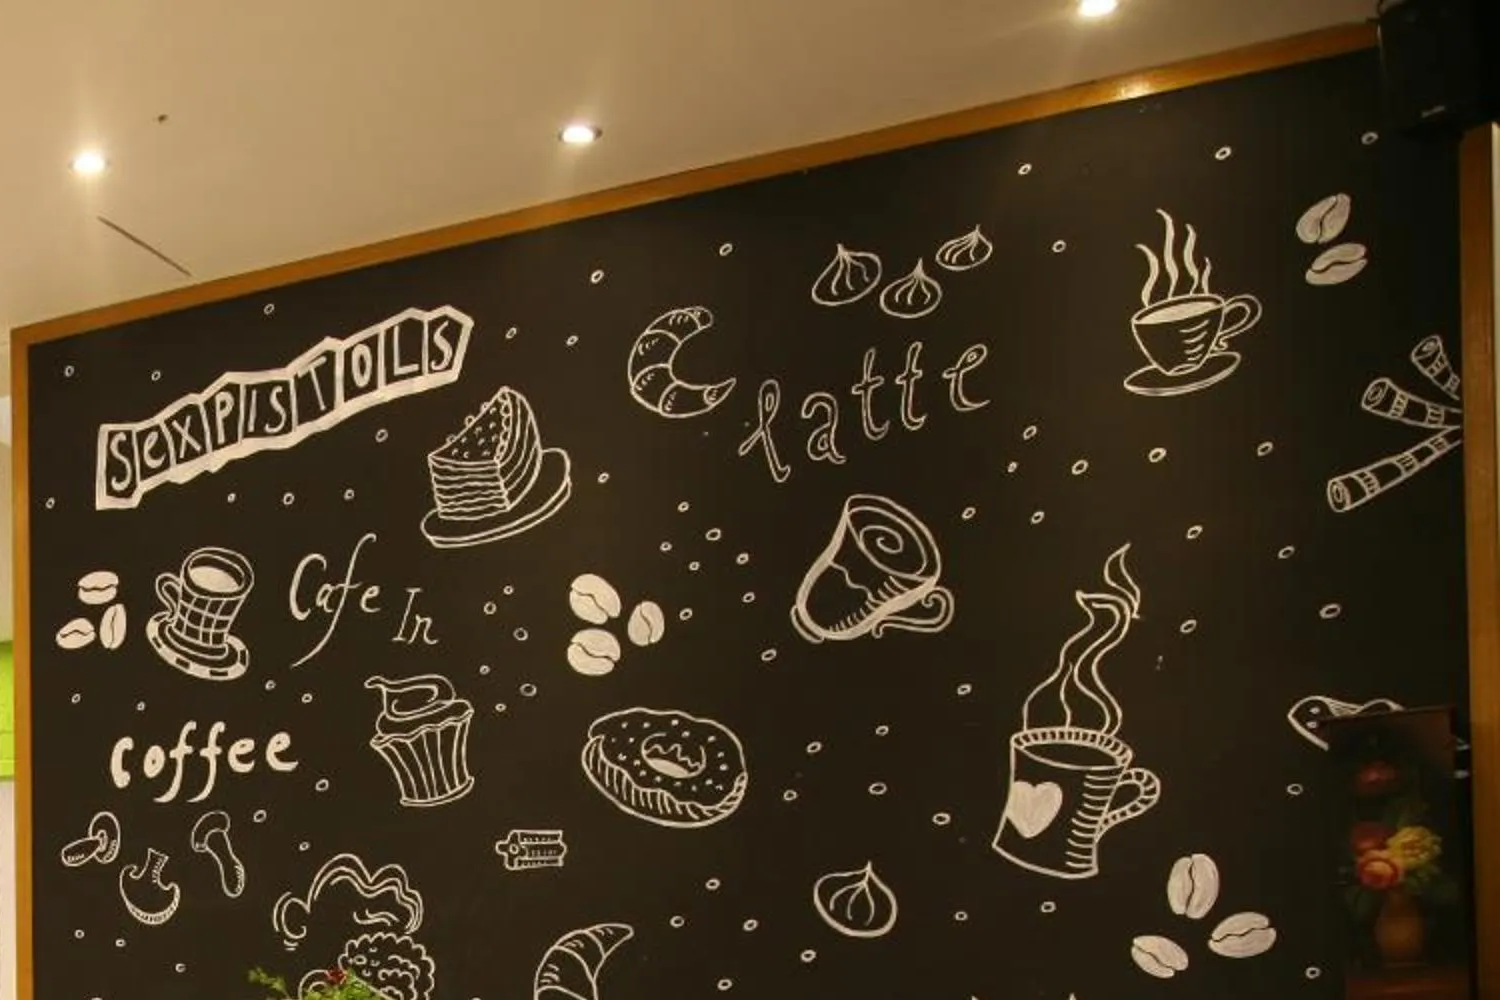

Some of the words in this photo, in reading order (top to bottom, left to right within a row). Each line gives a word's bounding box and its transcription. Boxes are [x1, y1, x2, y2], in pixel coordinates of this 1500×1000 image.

[739, 341, 990, 482] latte
[289, 532, 380, 668] Cafe
[392, 586, 439, 645] In
